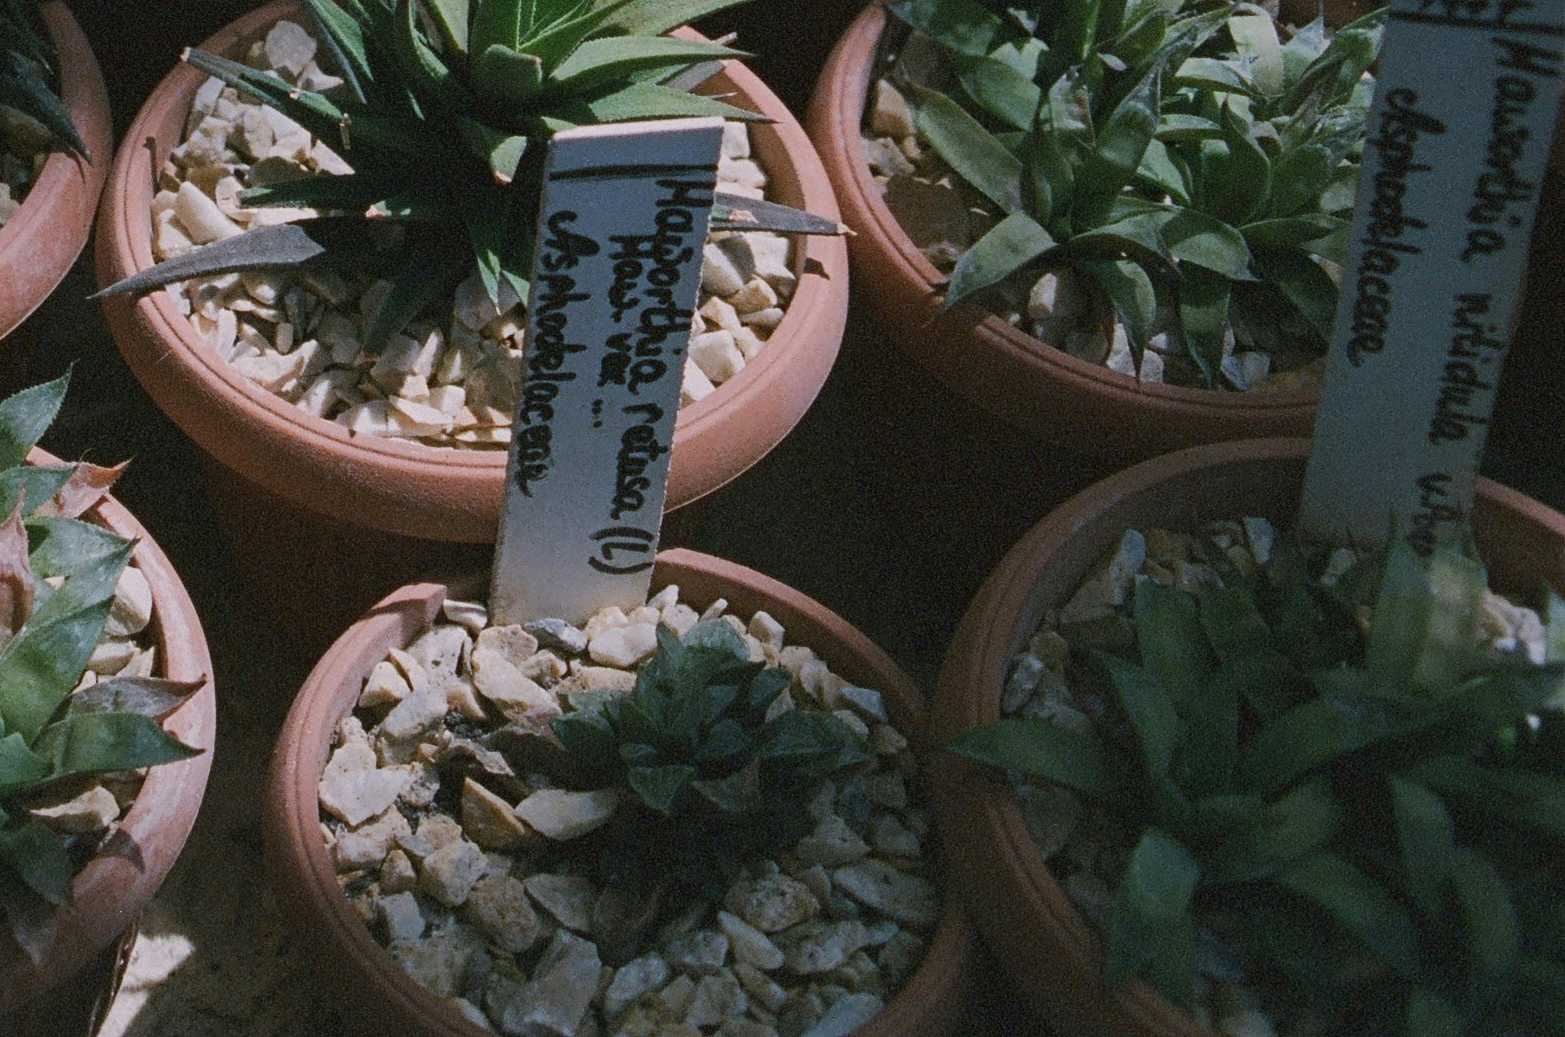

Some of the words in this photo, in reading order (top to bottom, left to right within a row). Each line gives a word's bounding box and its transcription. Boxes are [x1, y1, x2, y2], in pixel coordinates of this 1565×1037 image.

[628, 179, 716, 395] Haworthia
[1346, 88, 1447, 367] Asphodelaceae
[515, 210, 601, 498] Asphodelaceae
[611, 402, 669, 520] retusa
